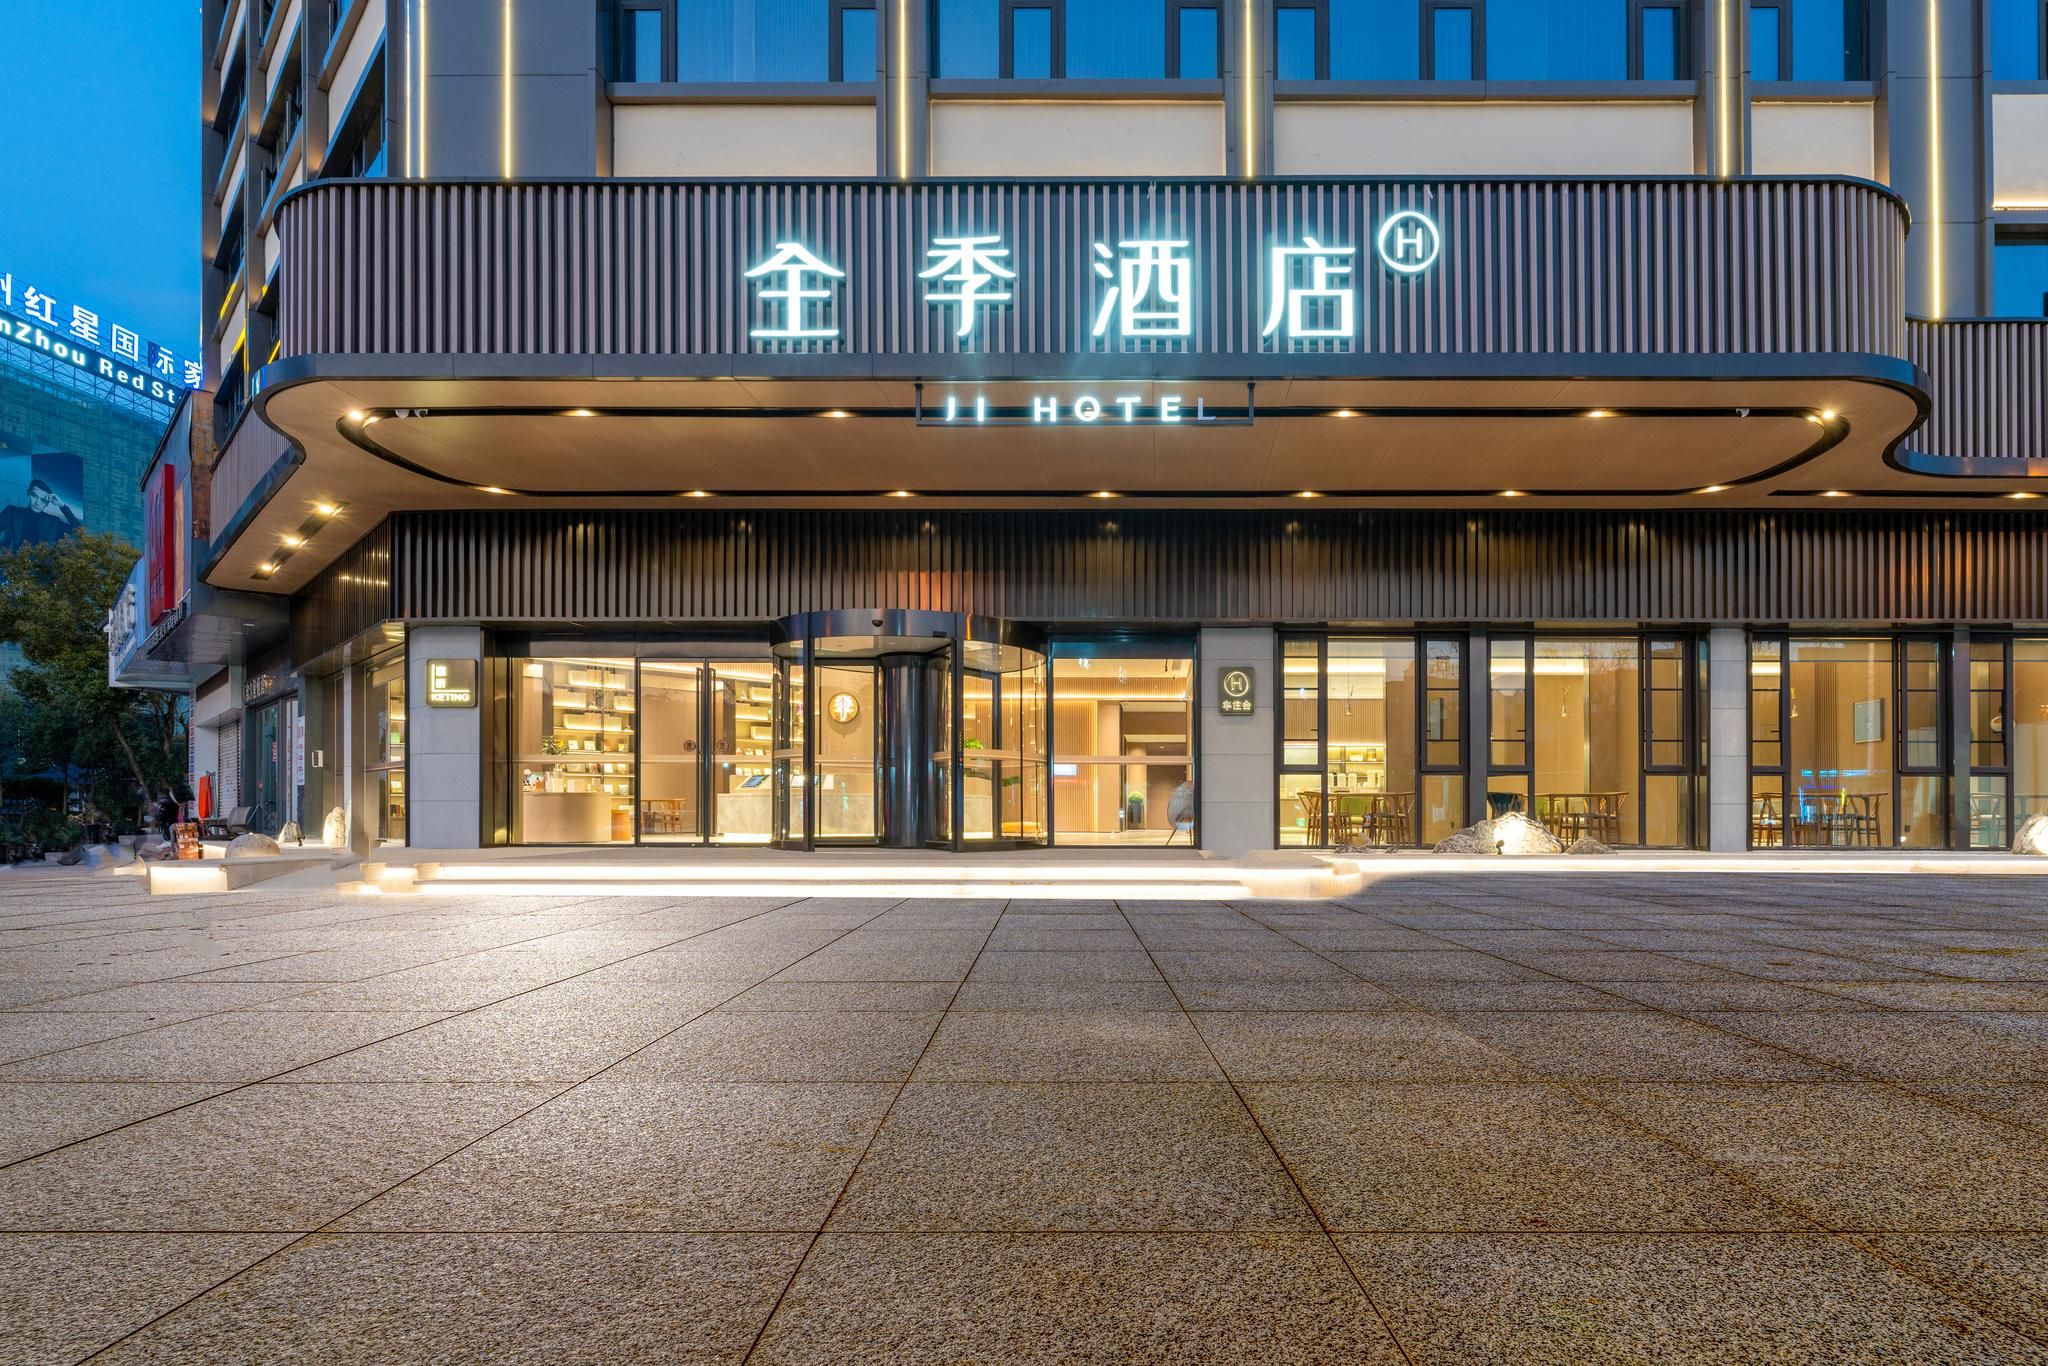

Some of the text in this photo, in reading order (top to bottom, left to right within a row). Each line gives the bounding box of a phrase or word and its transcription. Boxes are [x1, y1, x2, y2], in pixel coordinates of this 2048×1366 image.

[743, 235, 1357, 338] 全季酒店
[151, 381, 182, 405] St
[945, 395, 1217, 422] JI HOTEL
[431, 693, 471, 702] KETING
